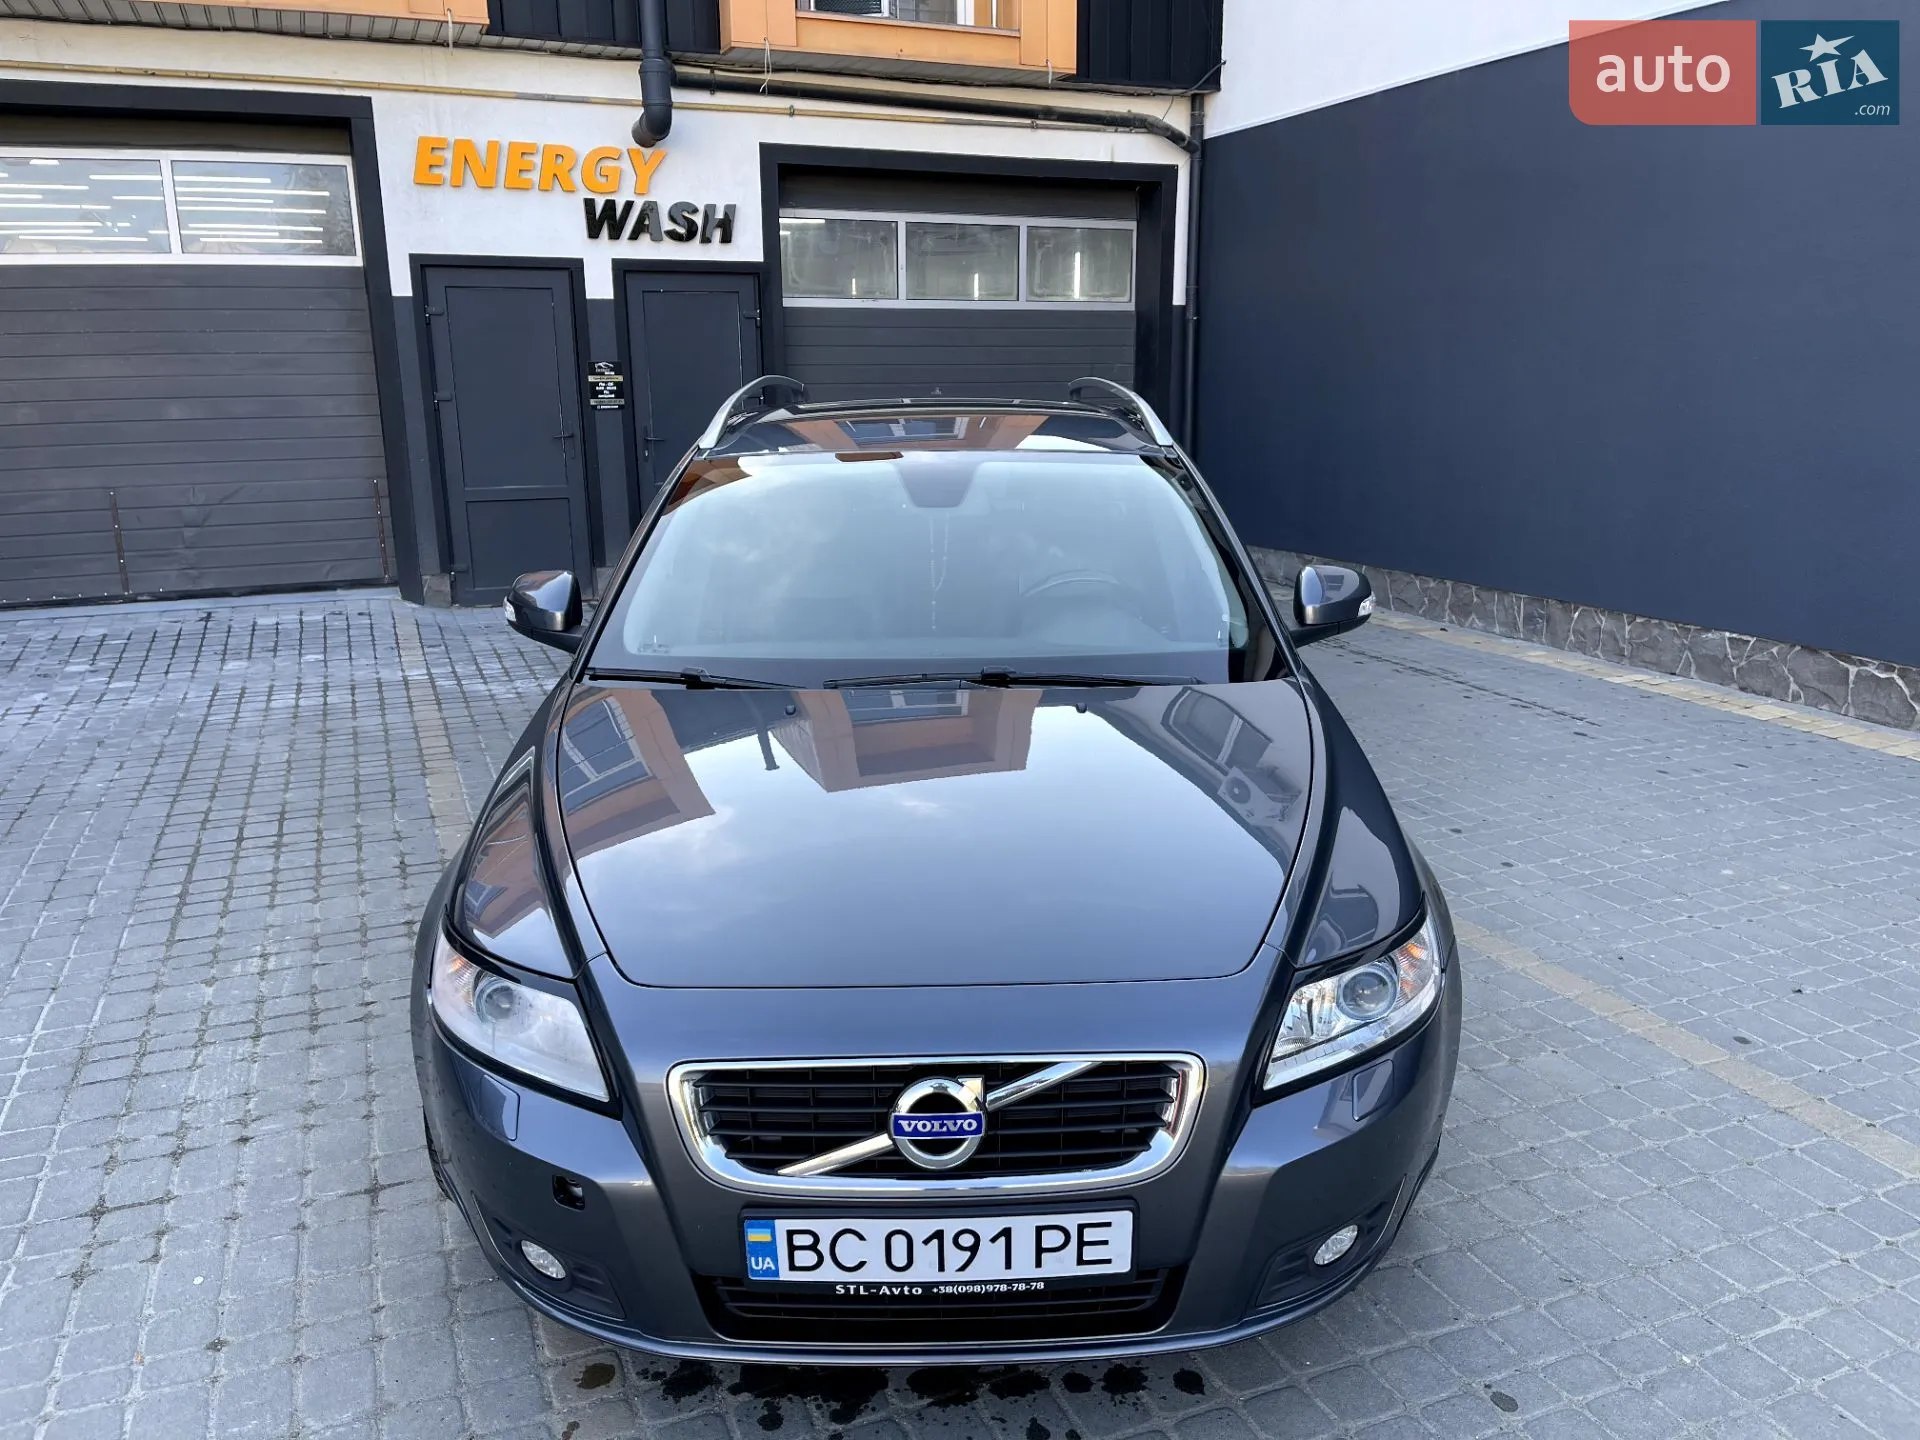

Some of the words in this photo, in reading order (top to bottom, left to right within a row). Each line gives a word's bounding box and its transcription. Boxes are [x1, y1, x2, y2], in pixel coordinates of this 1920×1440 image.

[413, 136, 666, 194] ENERGY
[583, 198, 737, 243] WASH
[898, 1119, 978, 1132] VOLVO
[786, 1228, 867, 1272] BC
[885, 1227, 1012, 1272] 0191
[1035, 1221, 1112, 1268] PE
[751, 1256, 775, 1270] UA
[835, 1284, 923, 1295] STL-Avto
[931, 1281, 1045, 1295] +38(098)978-78-78
